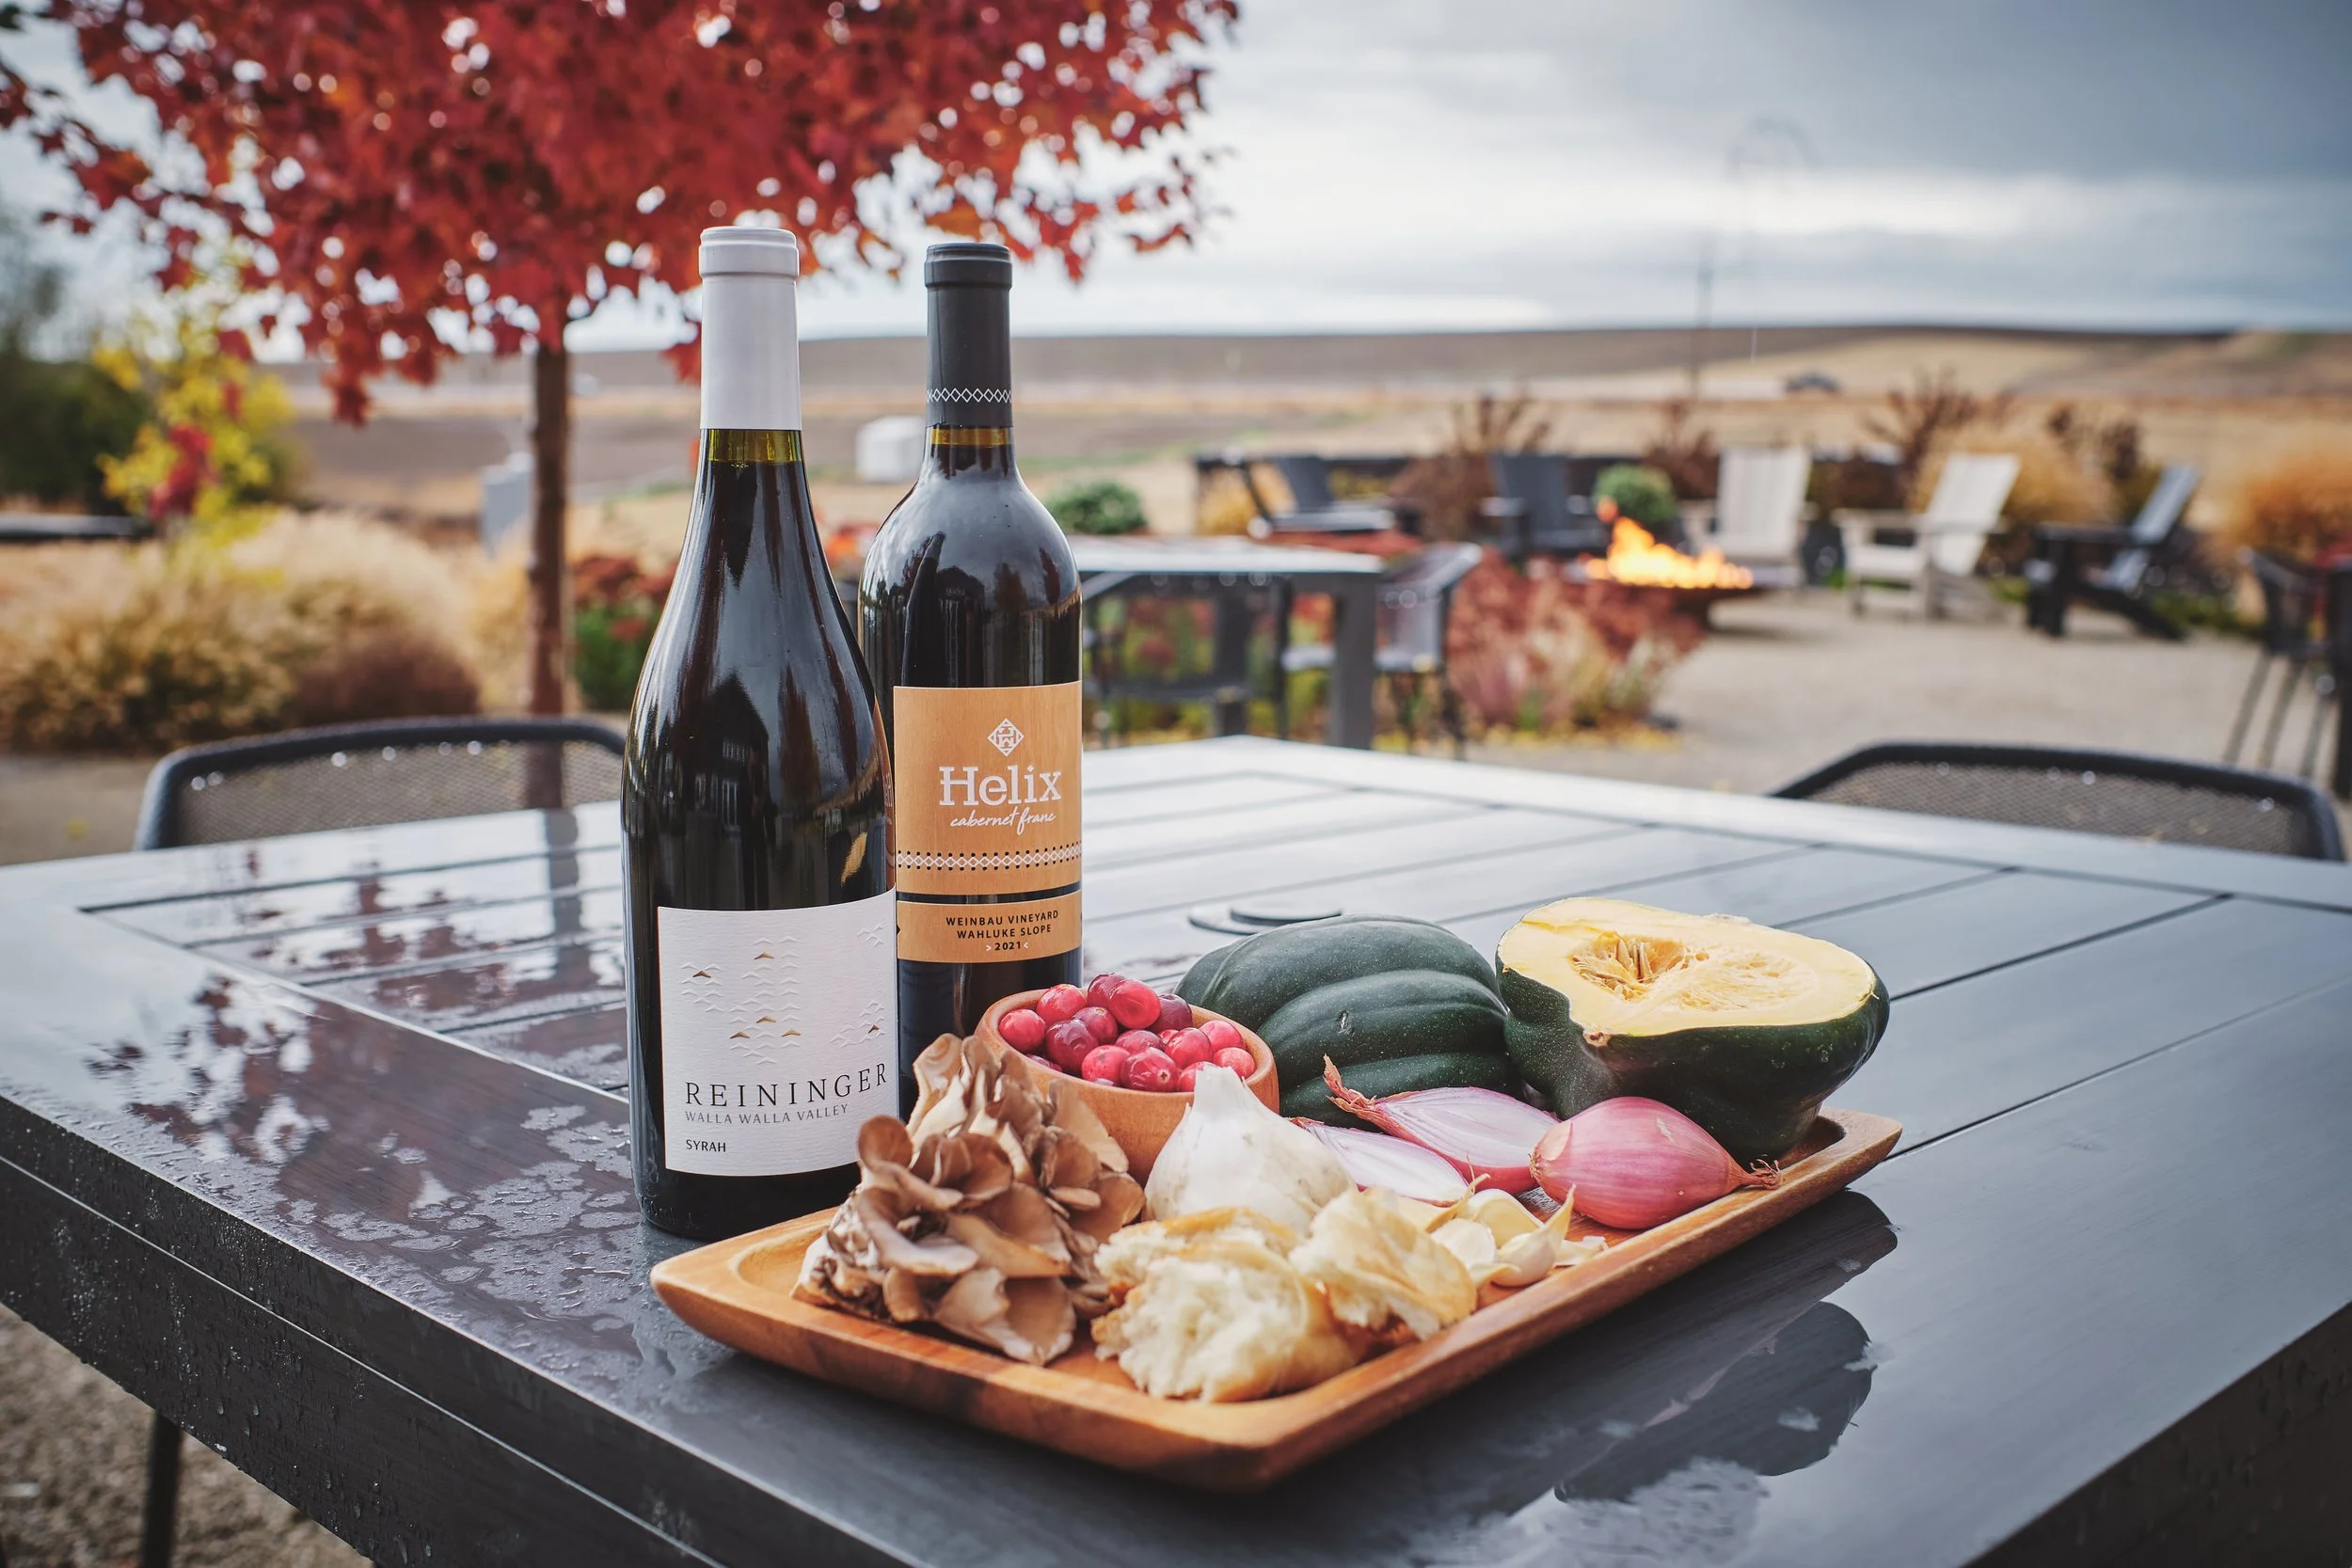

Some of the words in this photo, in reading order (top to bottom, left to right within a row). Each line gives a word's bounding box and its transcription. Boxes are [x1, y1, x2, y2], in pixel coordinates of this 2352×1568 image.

[939, 765, 1061, 806] Helix
[950, 810, 1017, 828] cabernet
[1016, 808, 1056, 835] franc
[946, 916, 1004, 927] WEINBAU
[1008, 910, 1059, 925] VINEYARD
[957, 927, 1016, 939] WAHLUKE
[1020, 924, 1052, 936] SLOPE
[994, 942, 1022, 951] 2021
[685, 1063, 887, 1107] REININGER
[685, 1111, 732, 1124] WALLA
[739, 1112, 791, 1124] WALLA
[797, 1103, 849, 1121] VALLEY
[686, 1139, 726, 1152] SYRAH
